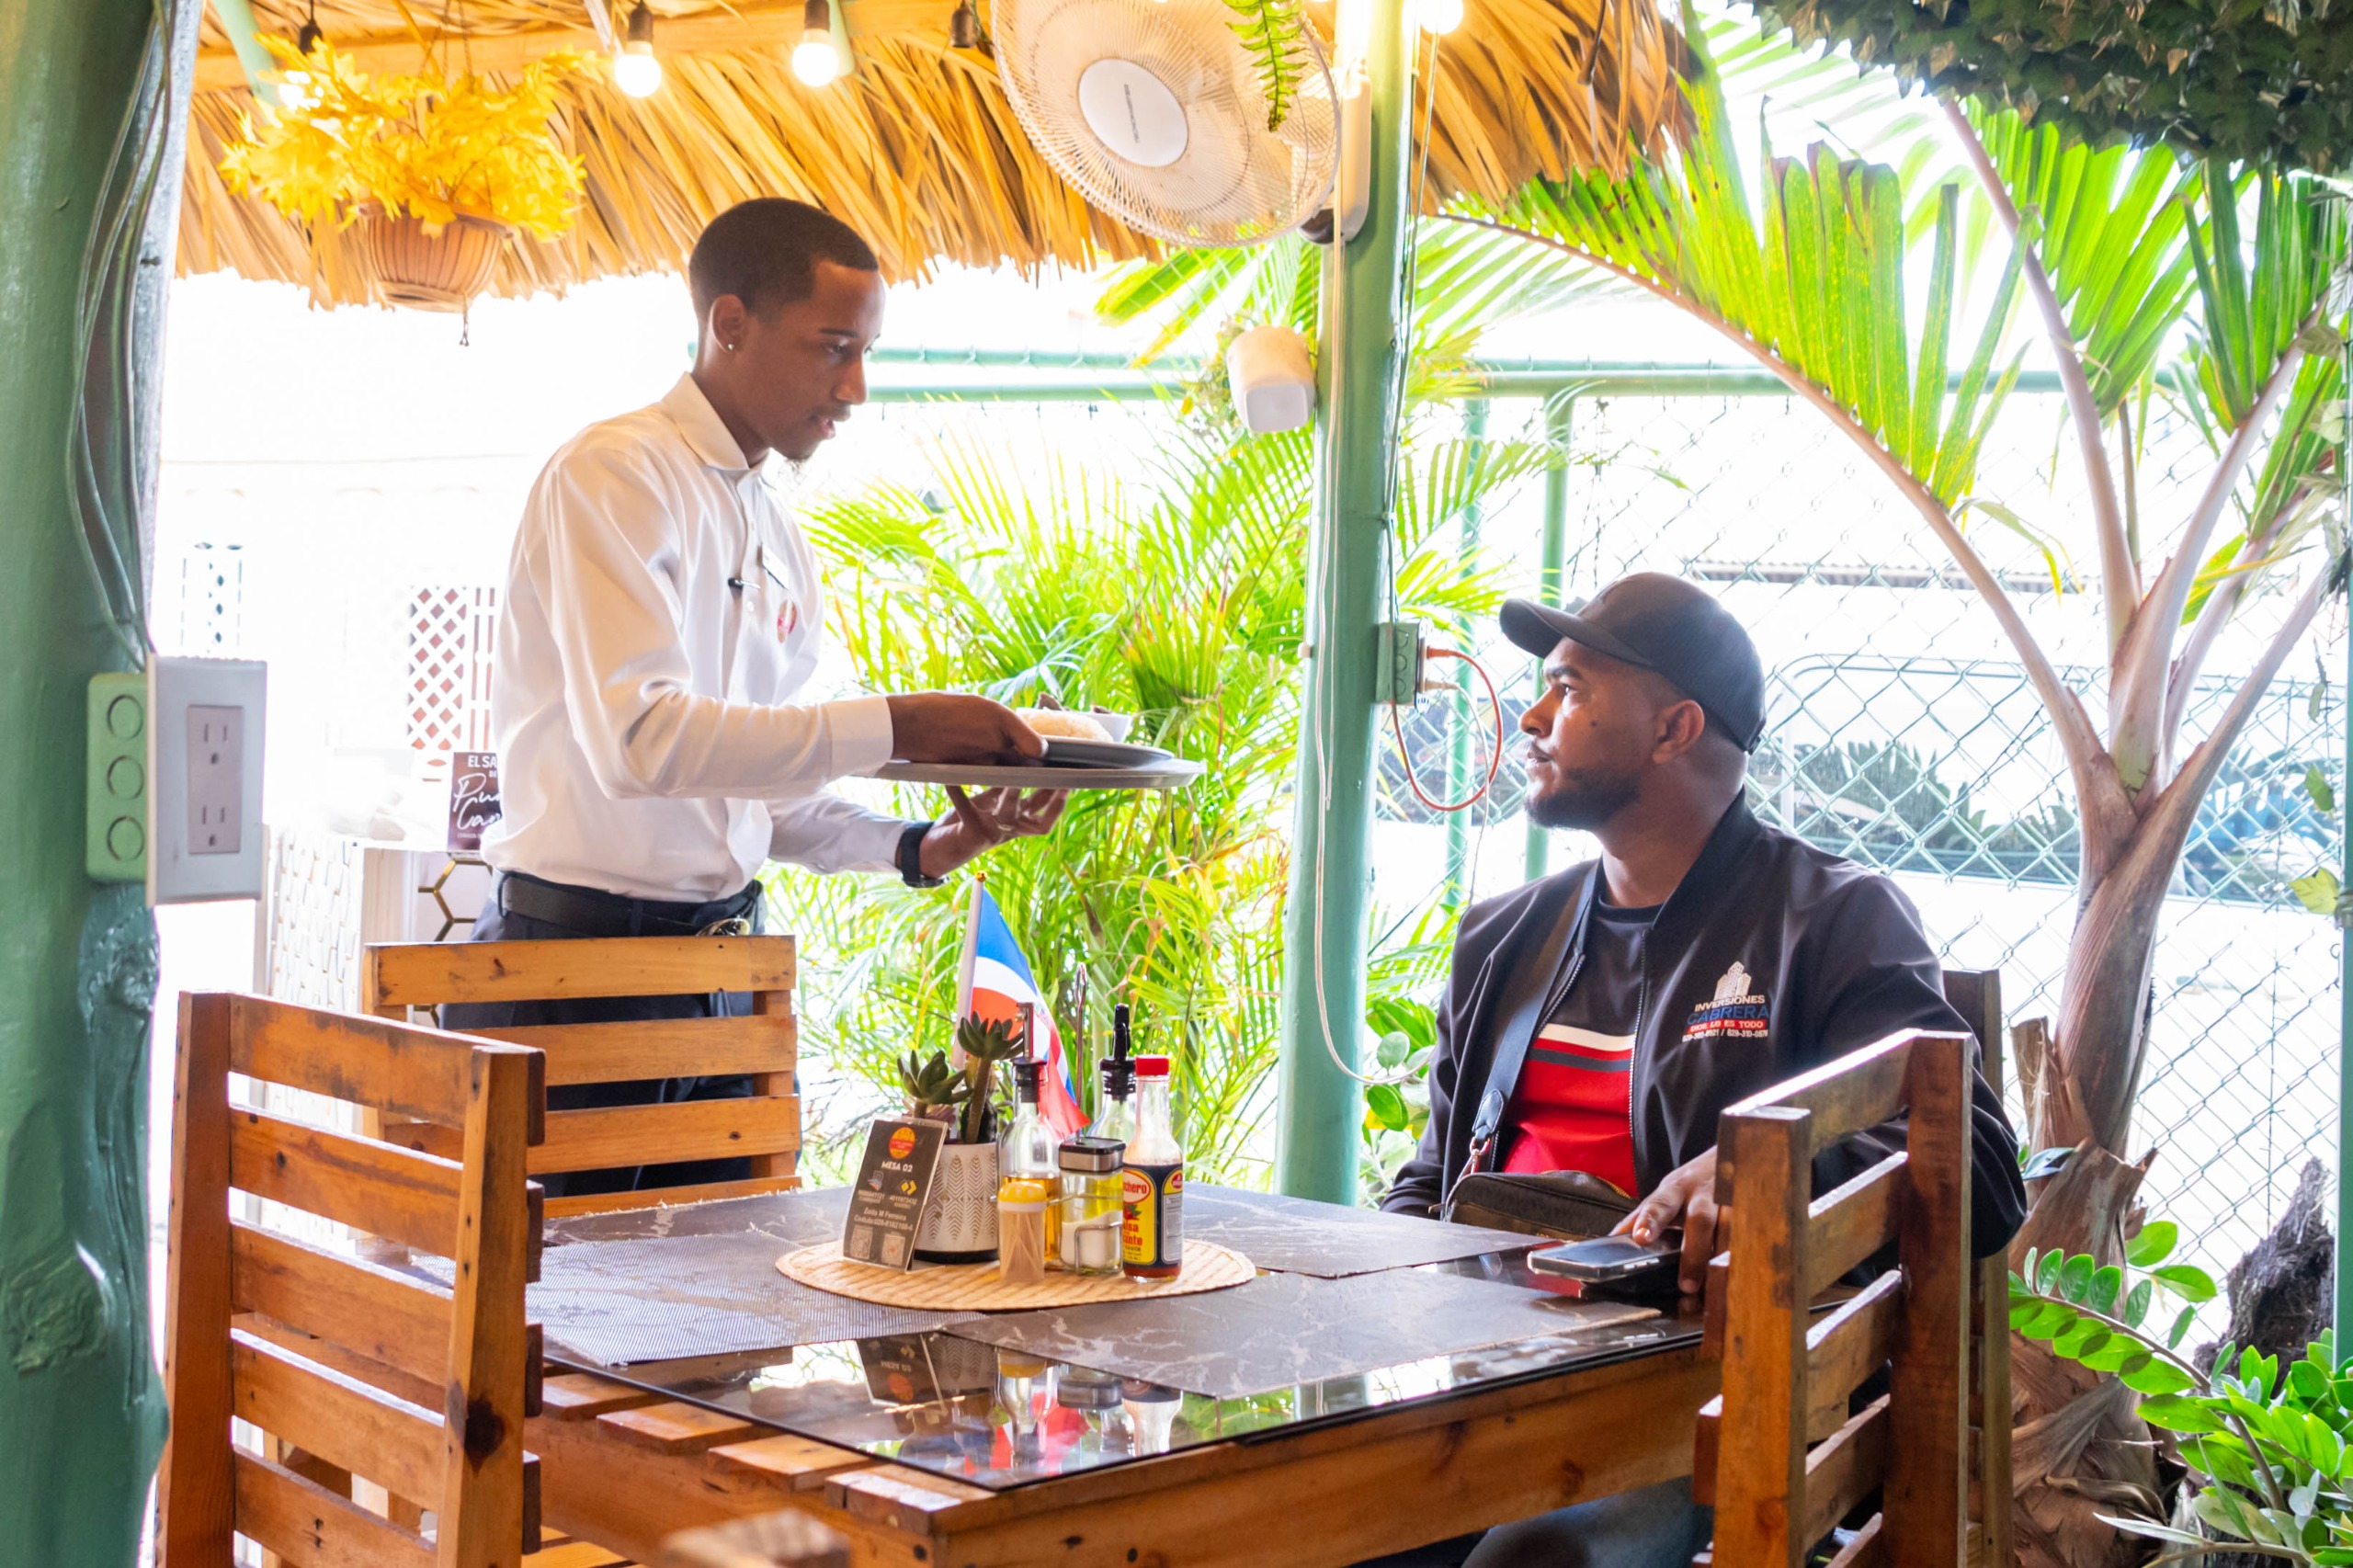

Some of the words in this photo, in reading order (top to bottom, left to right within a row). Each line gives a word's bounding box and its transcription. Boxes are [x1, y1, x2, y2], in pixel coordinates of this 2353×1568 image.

[468, 755, 481, 767] EL
[1694, 994, 1766, 1012] INVERSIONES
[1687, 1005, 1769, 1025] CABRERA
[1740, 1020, 1764, 1028] TODO
[881, 1161, 901, 1171] MESA
[902, 1164, 914, 1173] 02
[1123, 1181, 1147, 1194] chero
